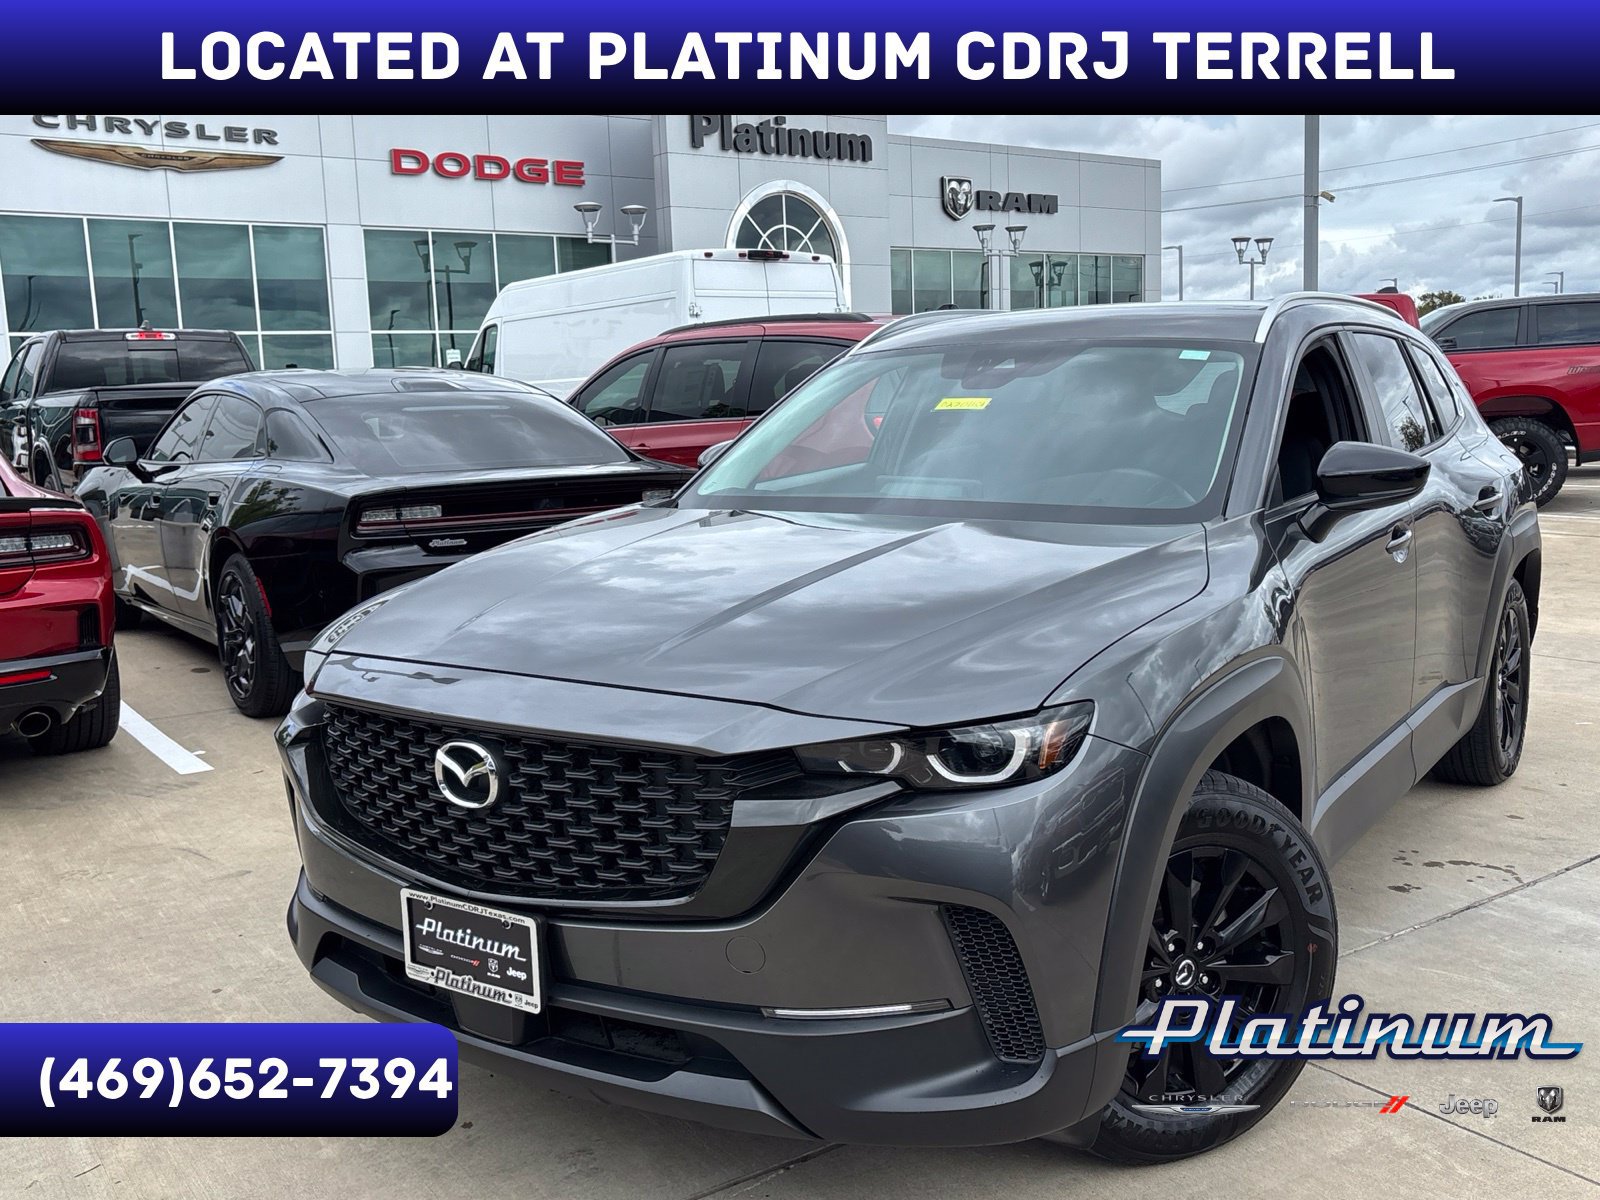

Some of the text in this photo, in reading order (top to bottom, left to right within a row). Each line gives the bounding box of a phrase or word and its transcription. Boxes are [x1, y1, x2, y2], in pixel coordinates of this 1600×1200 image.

[33, 115, 279, 145] CHRYSLER
[690, 115, 873, 162] Platinum
[390, 148, 585, 186] DODGE
[975, 190, 1058, 214] RAM
[408, 891, 526, 924] www.PlatinumCDRJTexas.com
[415, 917, 527, 962] Platinum
[433, 968, 512, 1004] Platinum
[506, 966, 527, 981] Jeep
